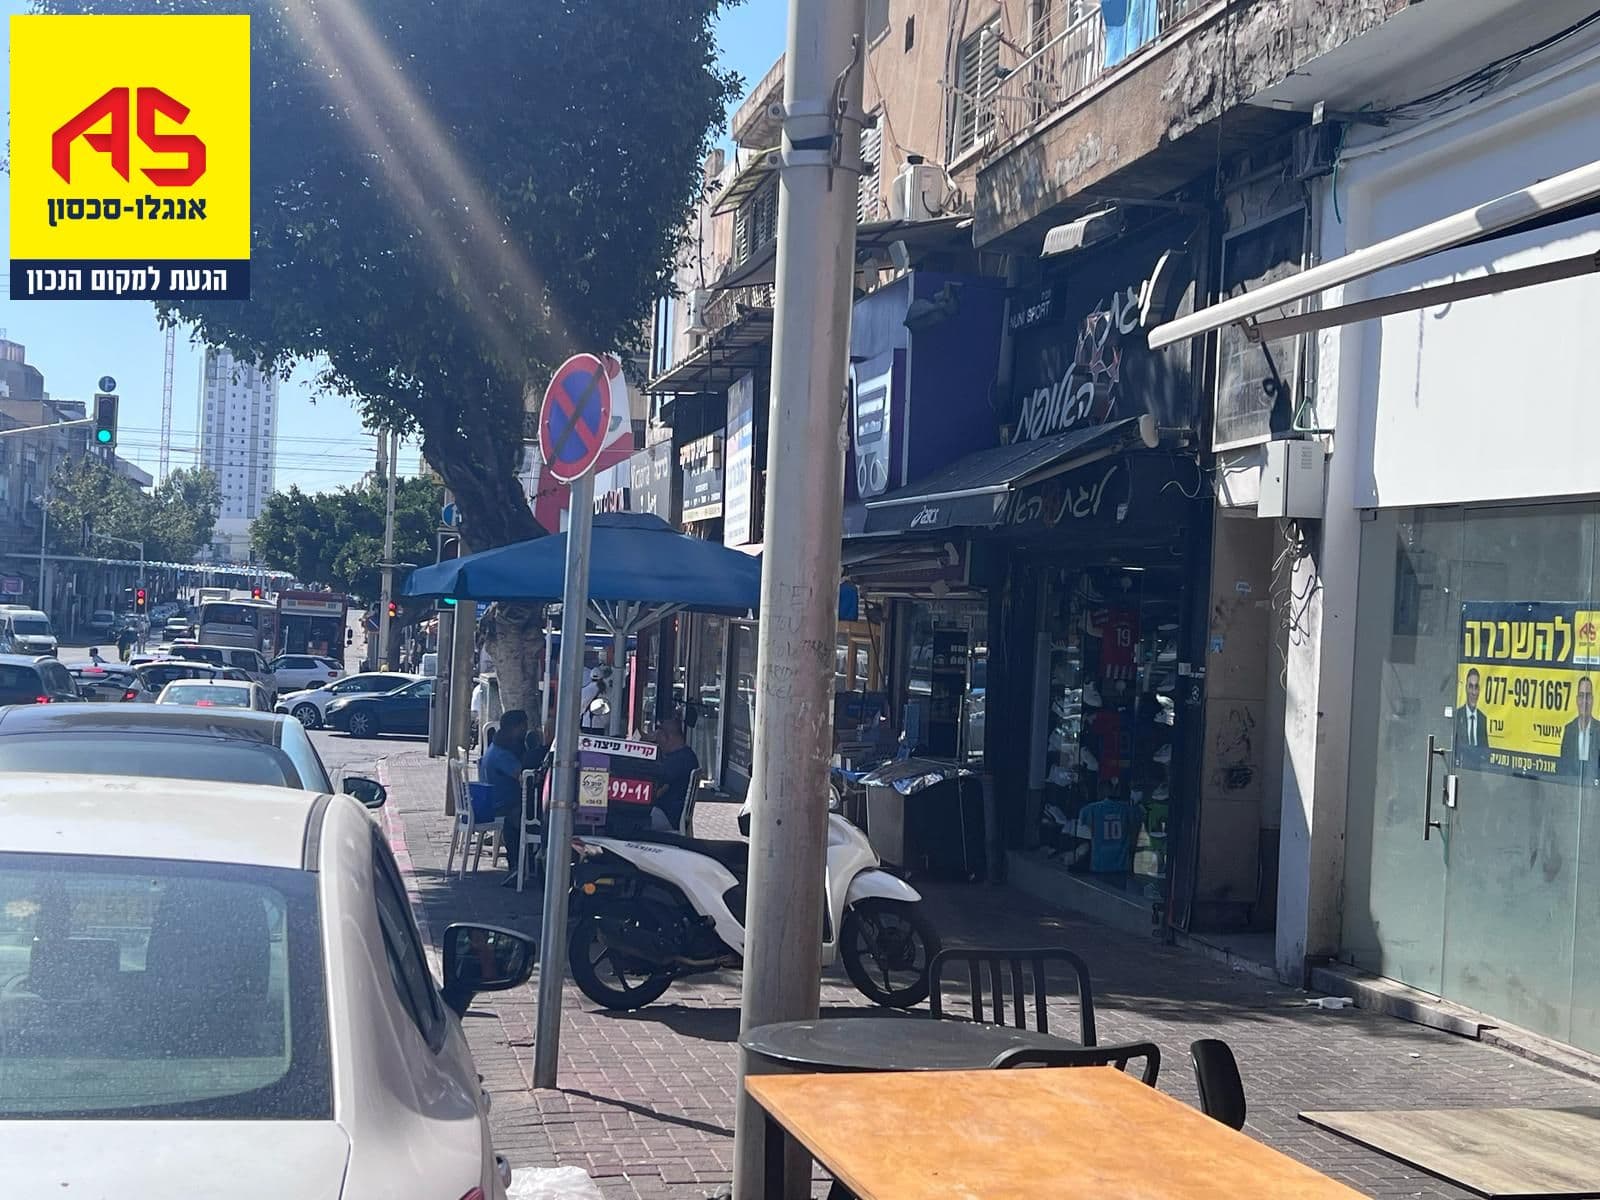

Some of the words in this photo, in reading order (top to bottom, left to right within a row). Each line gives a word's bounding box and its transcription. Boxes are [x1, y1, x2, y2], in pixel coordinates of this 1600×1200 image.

[1464, 615, 1571, 662] להשכרה
[1485, 675, 1571, 712] 077-9971667
[1489, 719, 1504, 733] ערן
[1533, 723, 1562, 738] אושרי
[593, 739, 621, 751] פיצה
[623, 742, 655, 757] קרייזי
